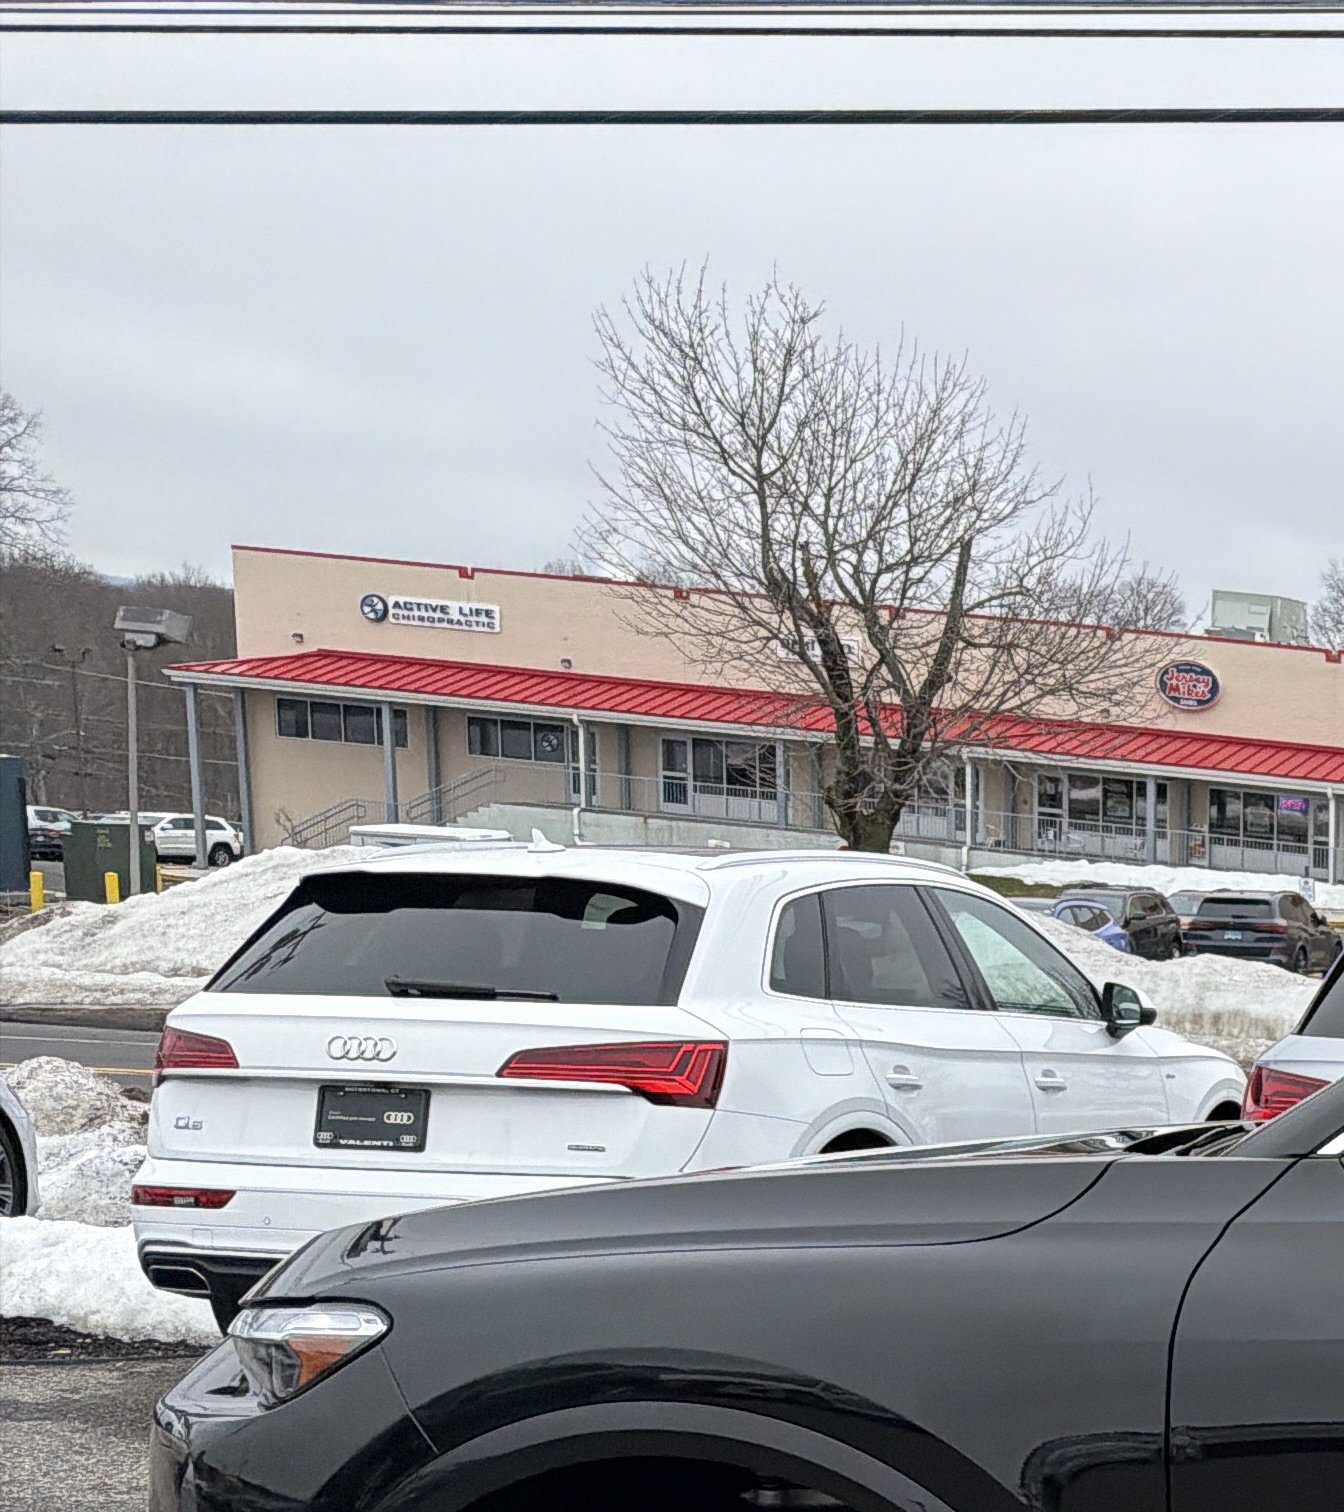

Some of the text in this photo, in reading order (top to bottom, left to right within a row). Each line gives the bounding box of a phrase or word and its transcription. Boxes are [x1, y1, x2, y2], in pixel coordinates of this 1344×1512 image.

[391, 600, 496, 620] ACTIVE LIFE
[391, 612, 496, 630] CHIROPRACTIC
[1163, 667, 1212, 688] Jersey
[1167, 682, 1212, 700] Mike's
[173, 1115, 204, 1130] Q5
